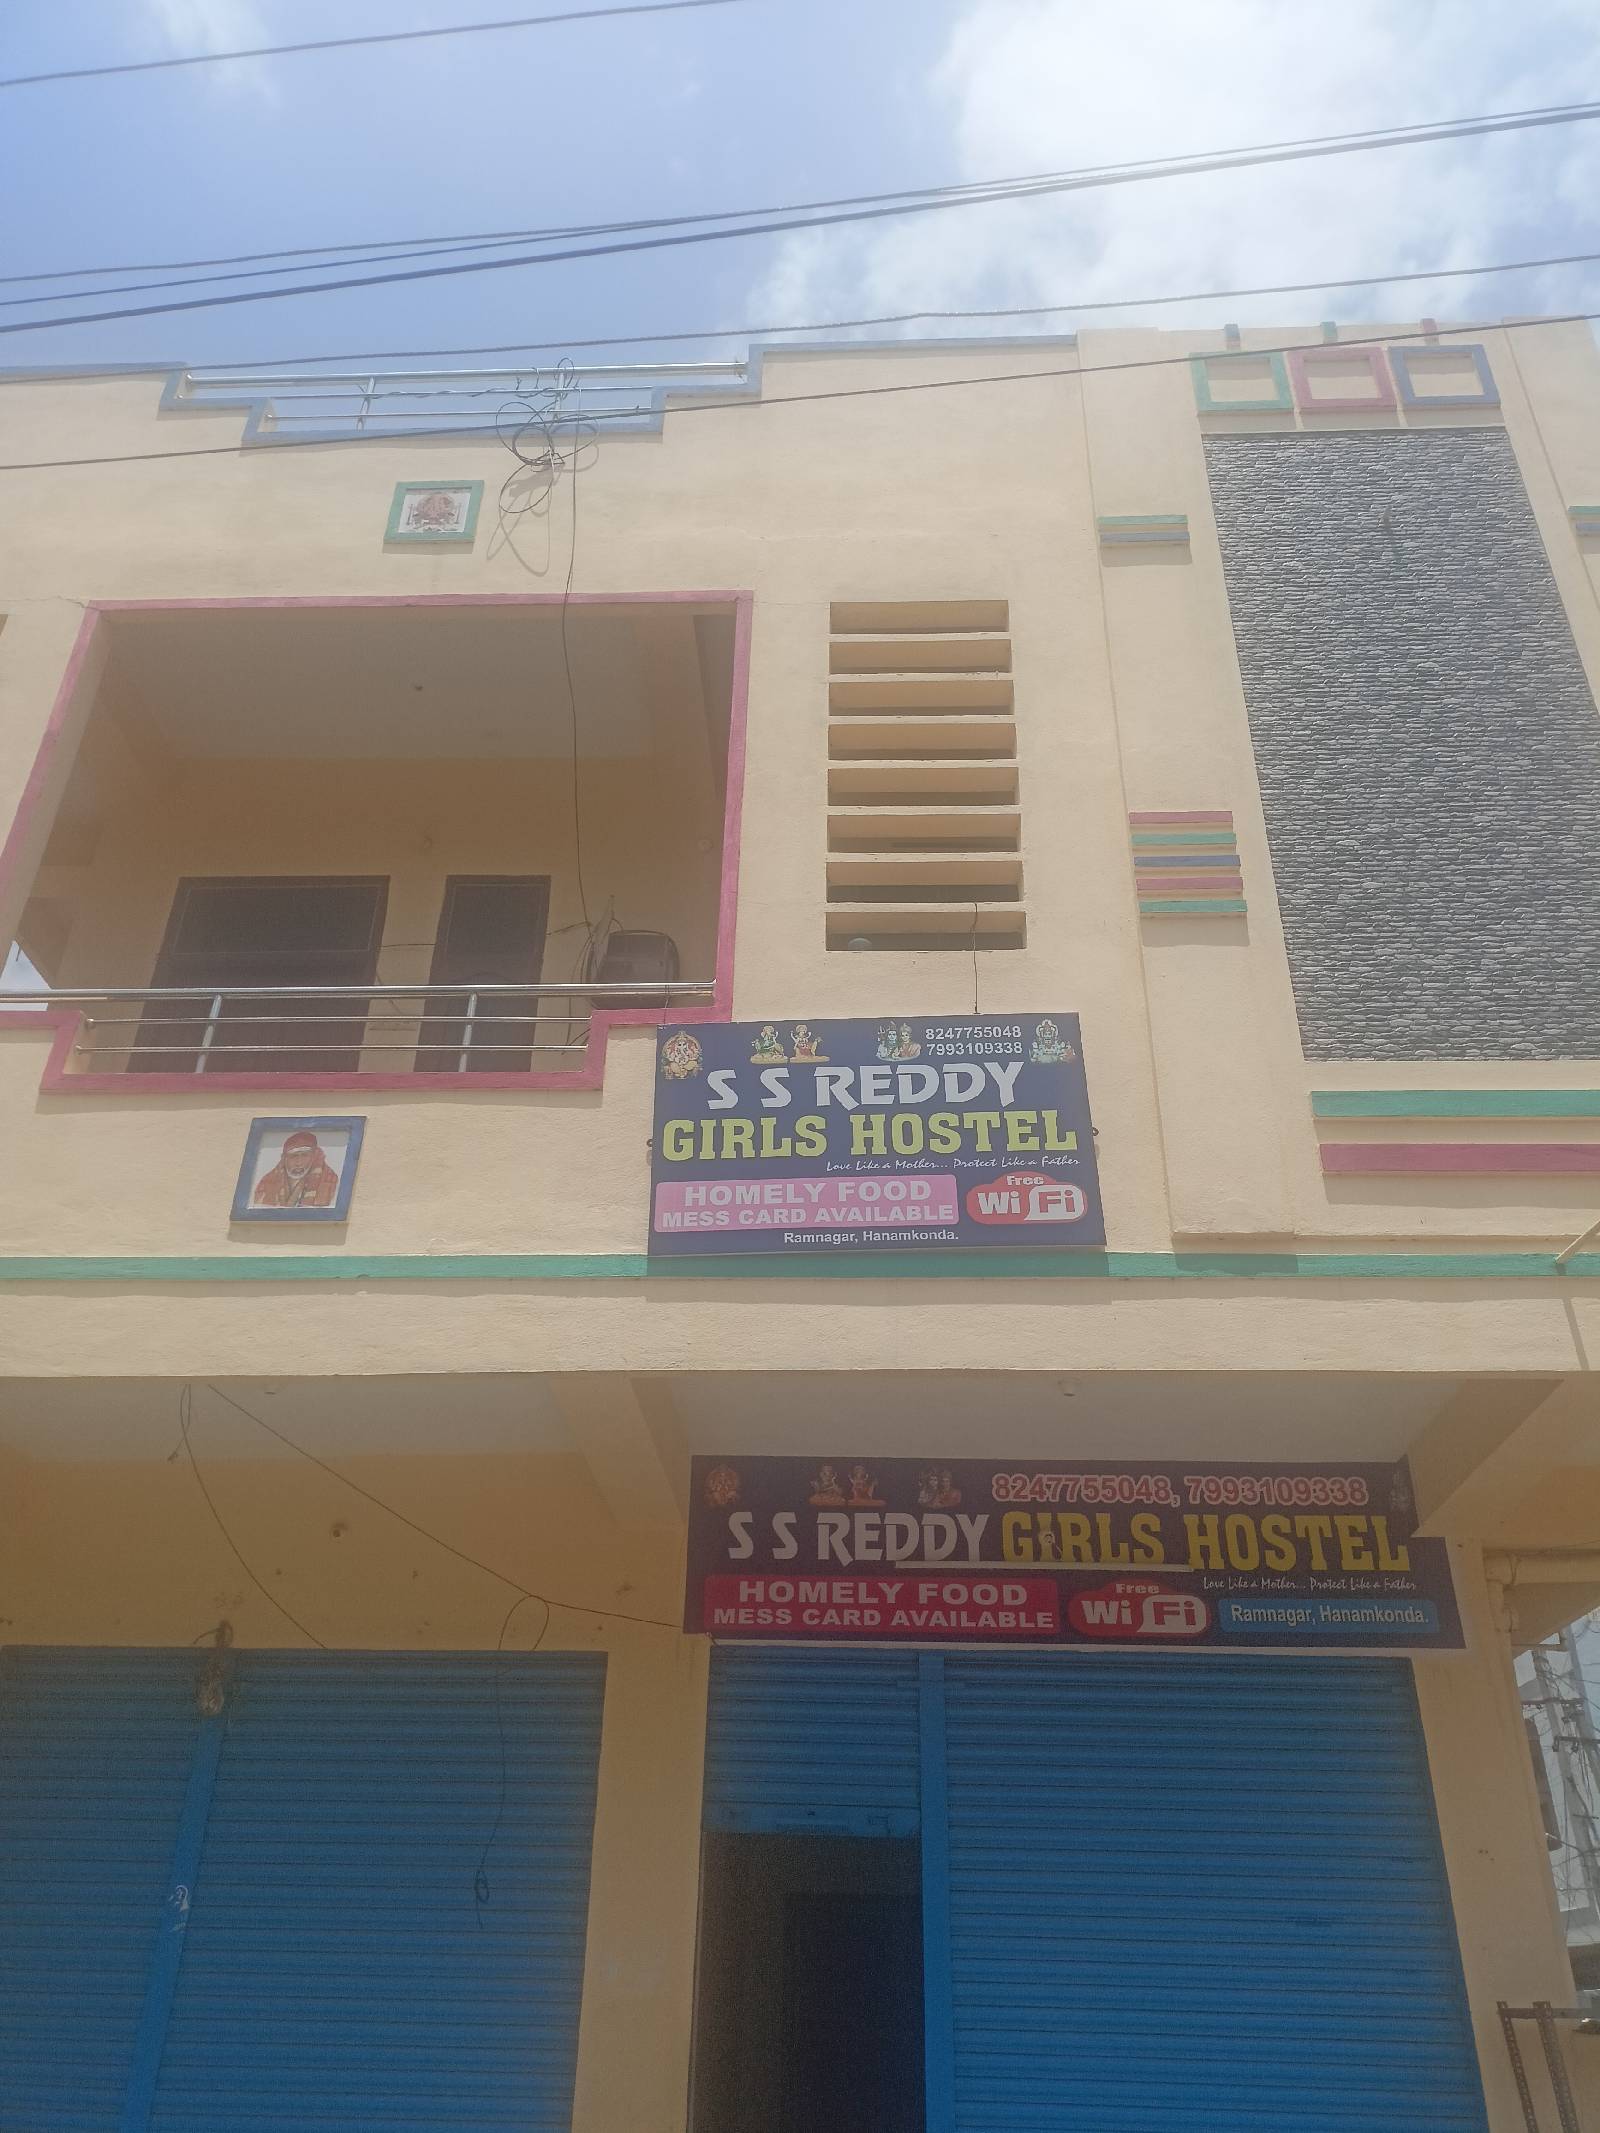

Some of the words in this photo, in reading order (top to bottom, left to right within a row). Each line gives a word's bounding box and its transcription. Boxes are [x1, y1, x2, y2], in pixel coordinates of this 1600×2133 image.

[926, 1025, 1022, 1040] 8247755048
[926, 1042, 1023, 1056] 7993109338
[707, 1069, 739, 1110] S
[760, 1067, 792, 1108] S
[814, 1061, 1025, 1111] REDDY
[663, 1115, 828, 1162] GIRLS
[850, 1109, 1078, 1155] HOSTEL
[826, 1160, 852, 1172] Love
[953, 1157, 998, 1170] Protect
[1041, 1155, 1081, 1168] Father
[1006, 1175, 1045, 1187] Free
[684, 1182, 827, 1207] HOMELY
[837, 1179, 932, 1203] FOOD
[662, 1210, 730, 1228] MESS
[738, 1207, 807, 1225] CARD
[814, 1204, 954, 1225] AVAILABLE
[783, 1232, 859, 1245] Ramnagar,
[863, 1229, 959, 1242] Hanamkonda.
[1184, 1475, 1369, 1507] 7993109338
[727, 1511, 754, 1560] S
[771, 1511, 799, 1560] S
[816, 1511, 990, 1567] REDDY
[1002, 1511, 1165, 1564] GIRLS
[1183, 1513, 1411, 1572] HOSTEL
[738, 1580, 905, 1605] HOMELY
[918, 1583, 1028, 1606] FOOD
[1115, 1583, 1161, 1595] Free
[1309, 1576, 1347, 1590] Protect
[1384, 1577, 1417, 1592] Father
[713, 1608, 793, 1625] MESS
[802, 1608, 881, 1626] CARD
[889, 1608, 1054, 1629] AVAILABLE
[1230, 1604, 1316, 1626] Ramnagar,
[1320, 1604, 1430, 1625] Hanamkonda.
